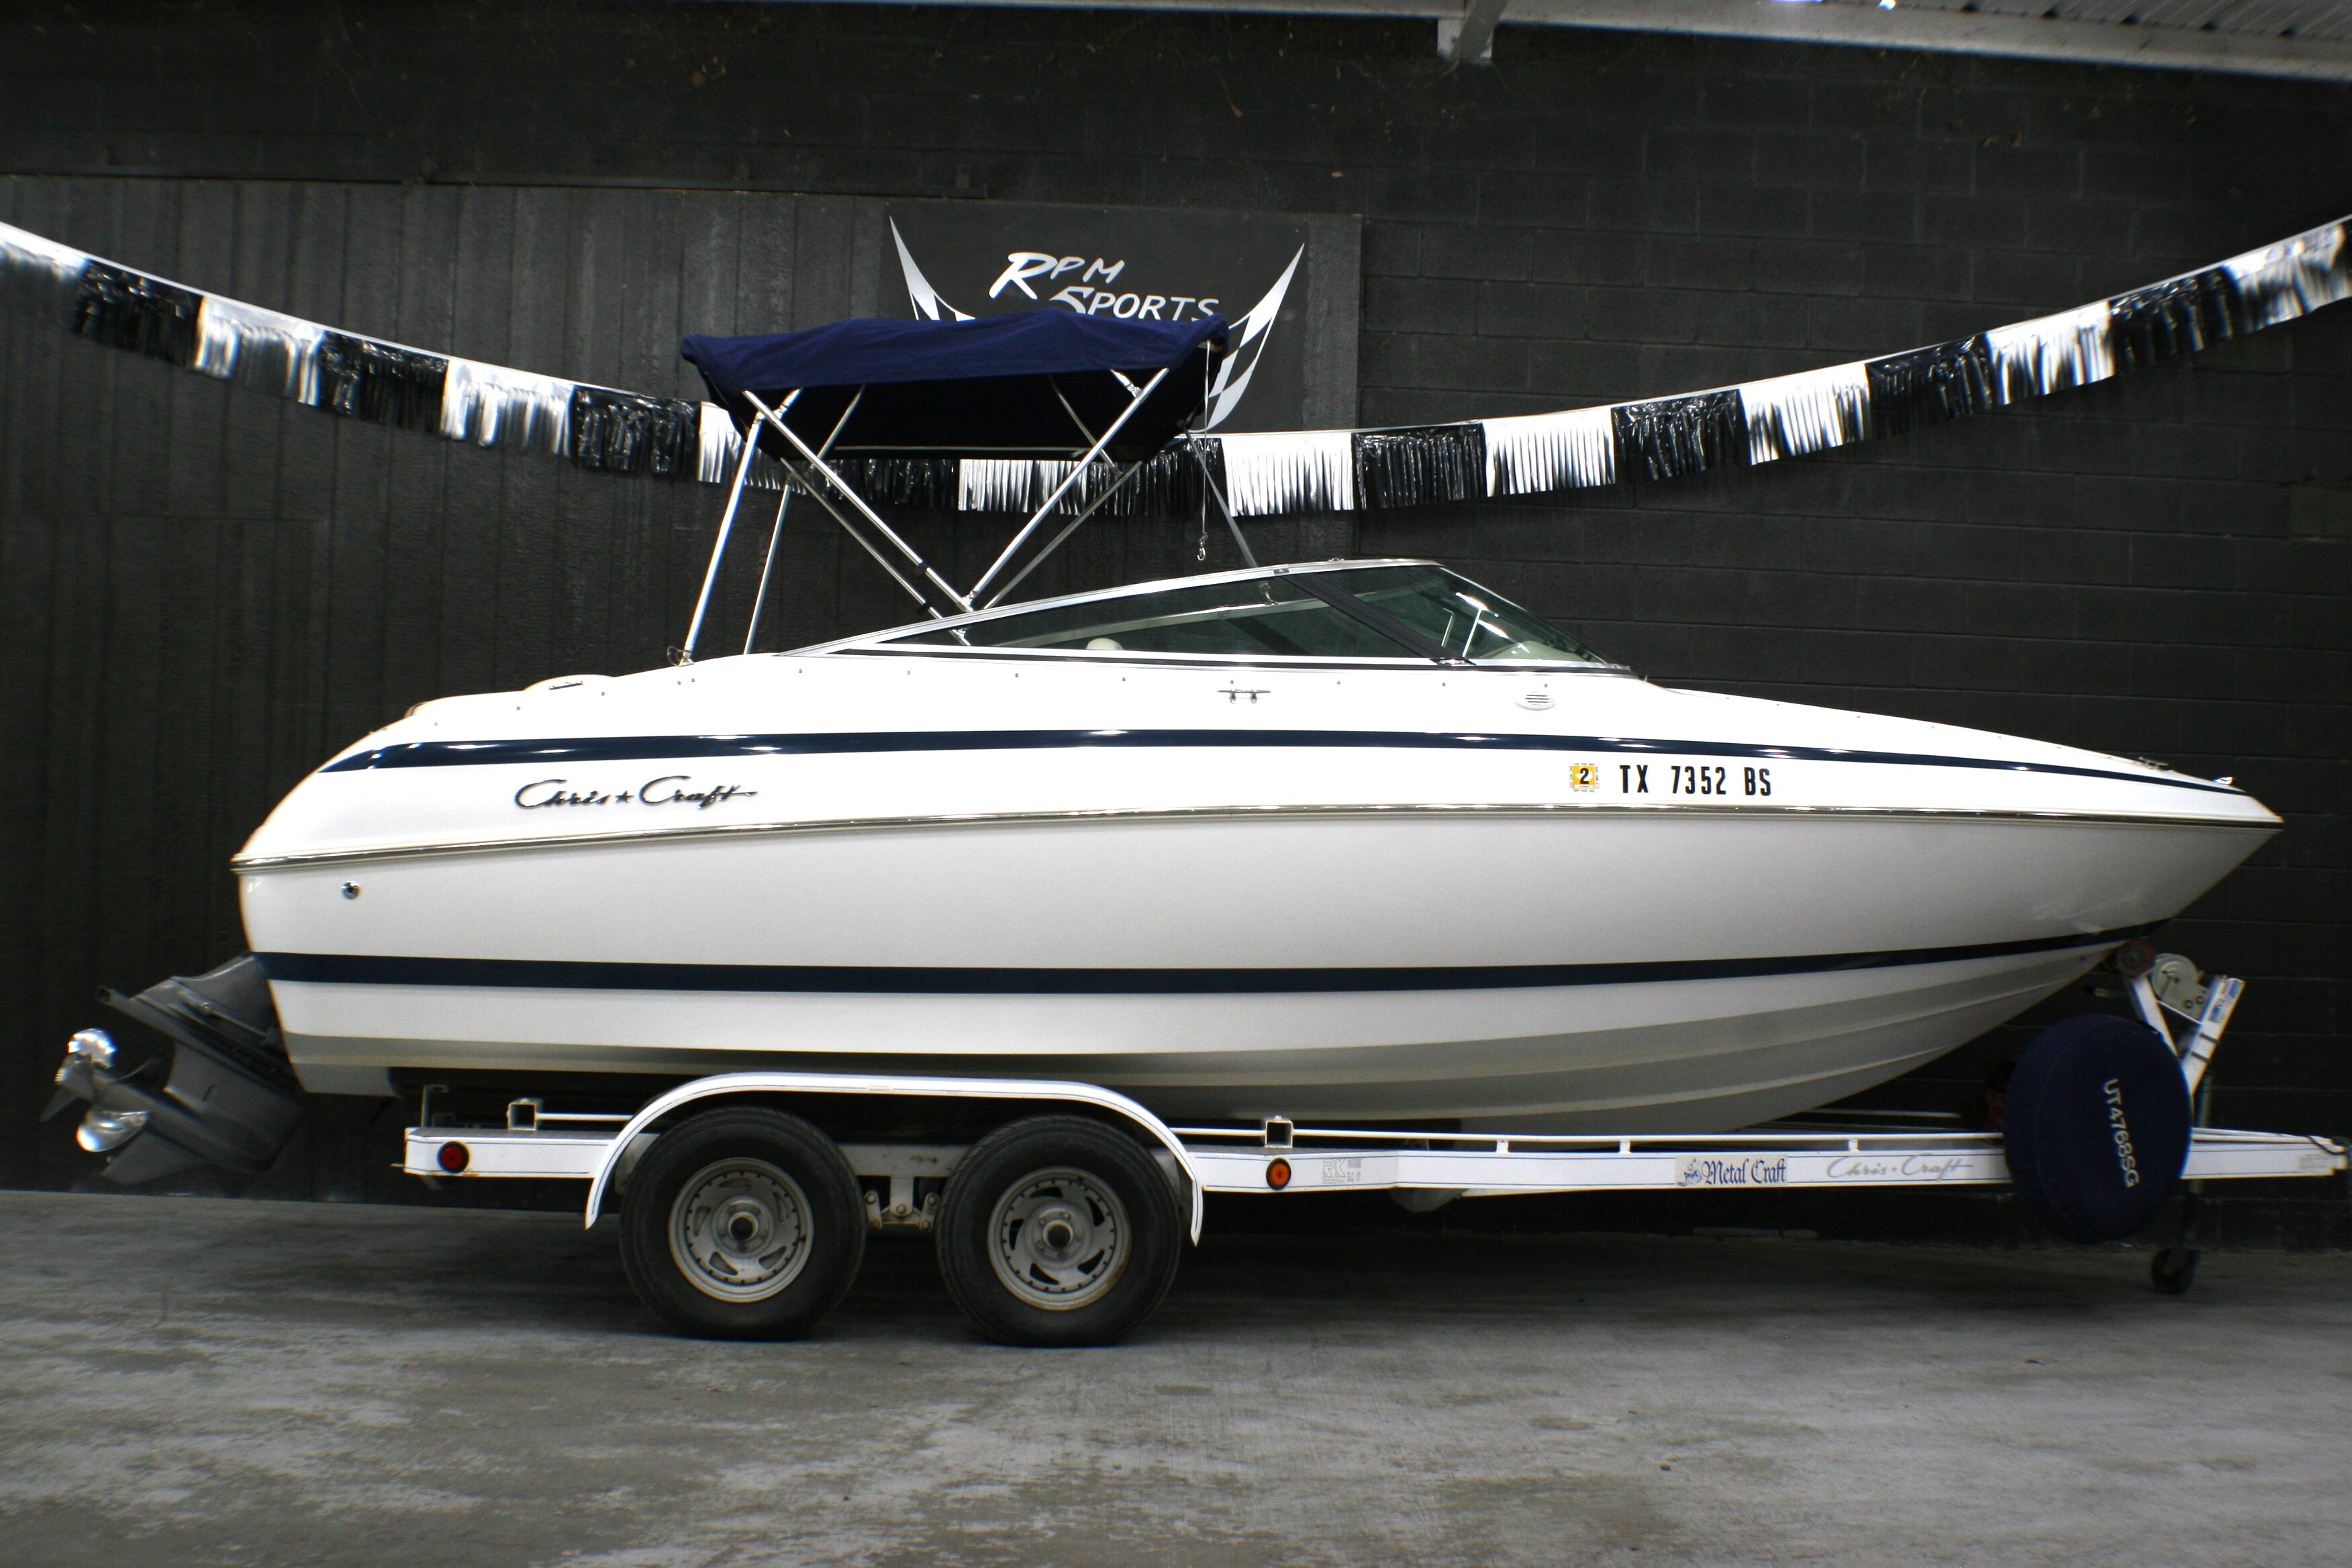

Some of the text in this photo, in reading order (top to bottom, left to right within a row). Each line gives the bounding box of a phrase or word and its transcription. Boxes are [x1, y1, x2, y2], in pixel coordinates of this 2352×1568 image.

[989, 252, 1124, 299] RPM
[1579, 767, 1589, 785] 2
[1619, 765, 1649, 794] TX
[1671, 765, 1726, 795] 7352
[1744, 767, 1771, 797] BS
[1701, 1158, 1786, 1185] Metal Craft
